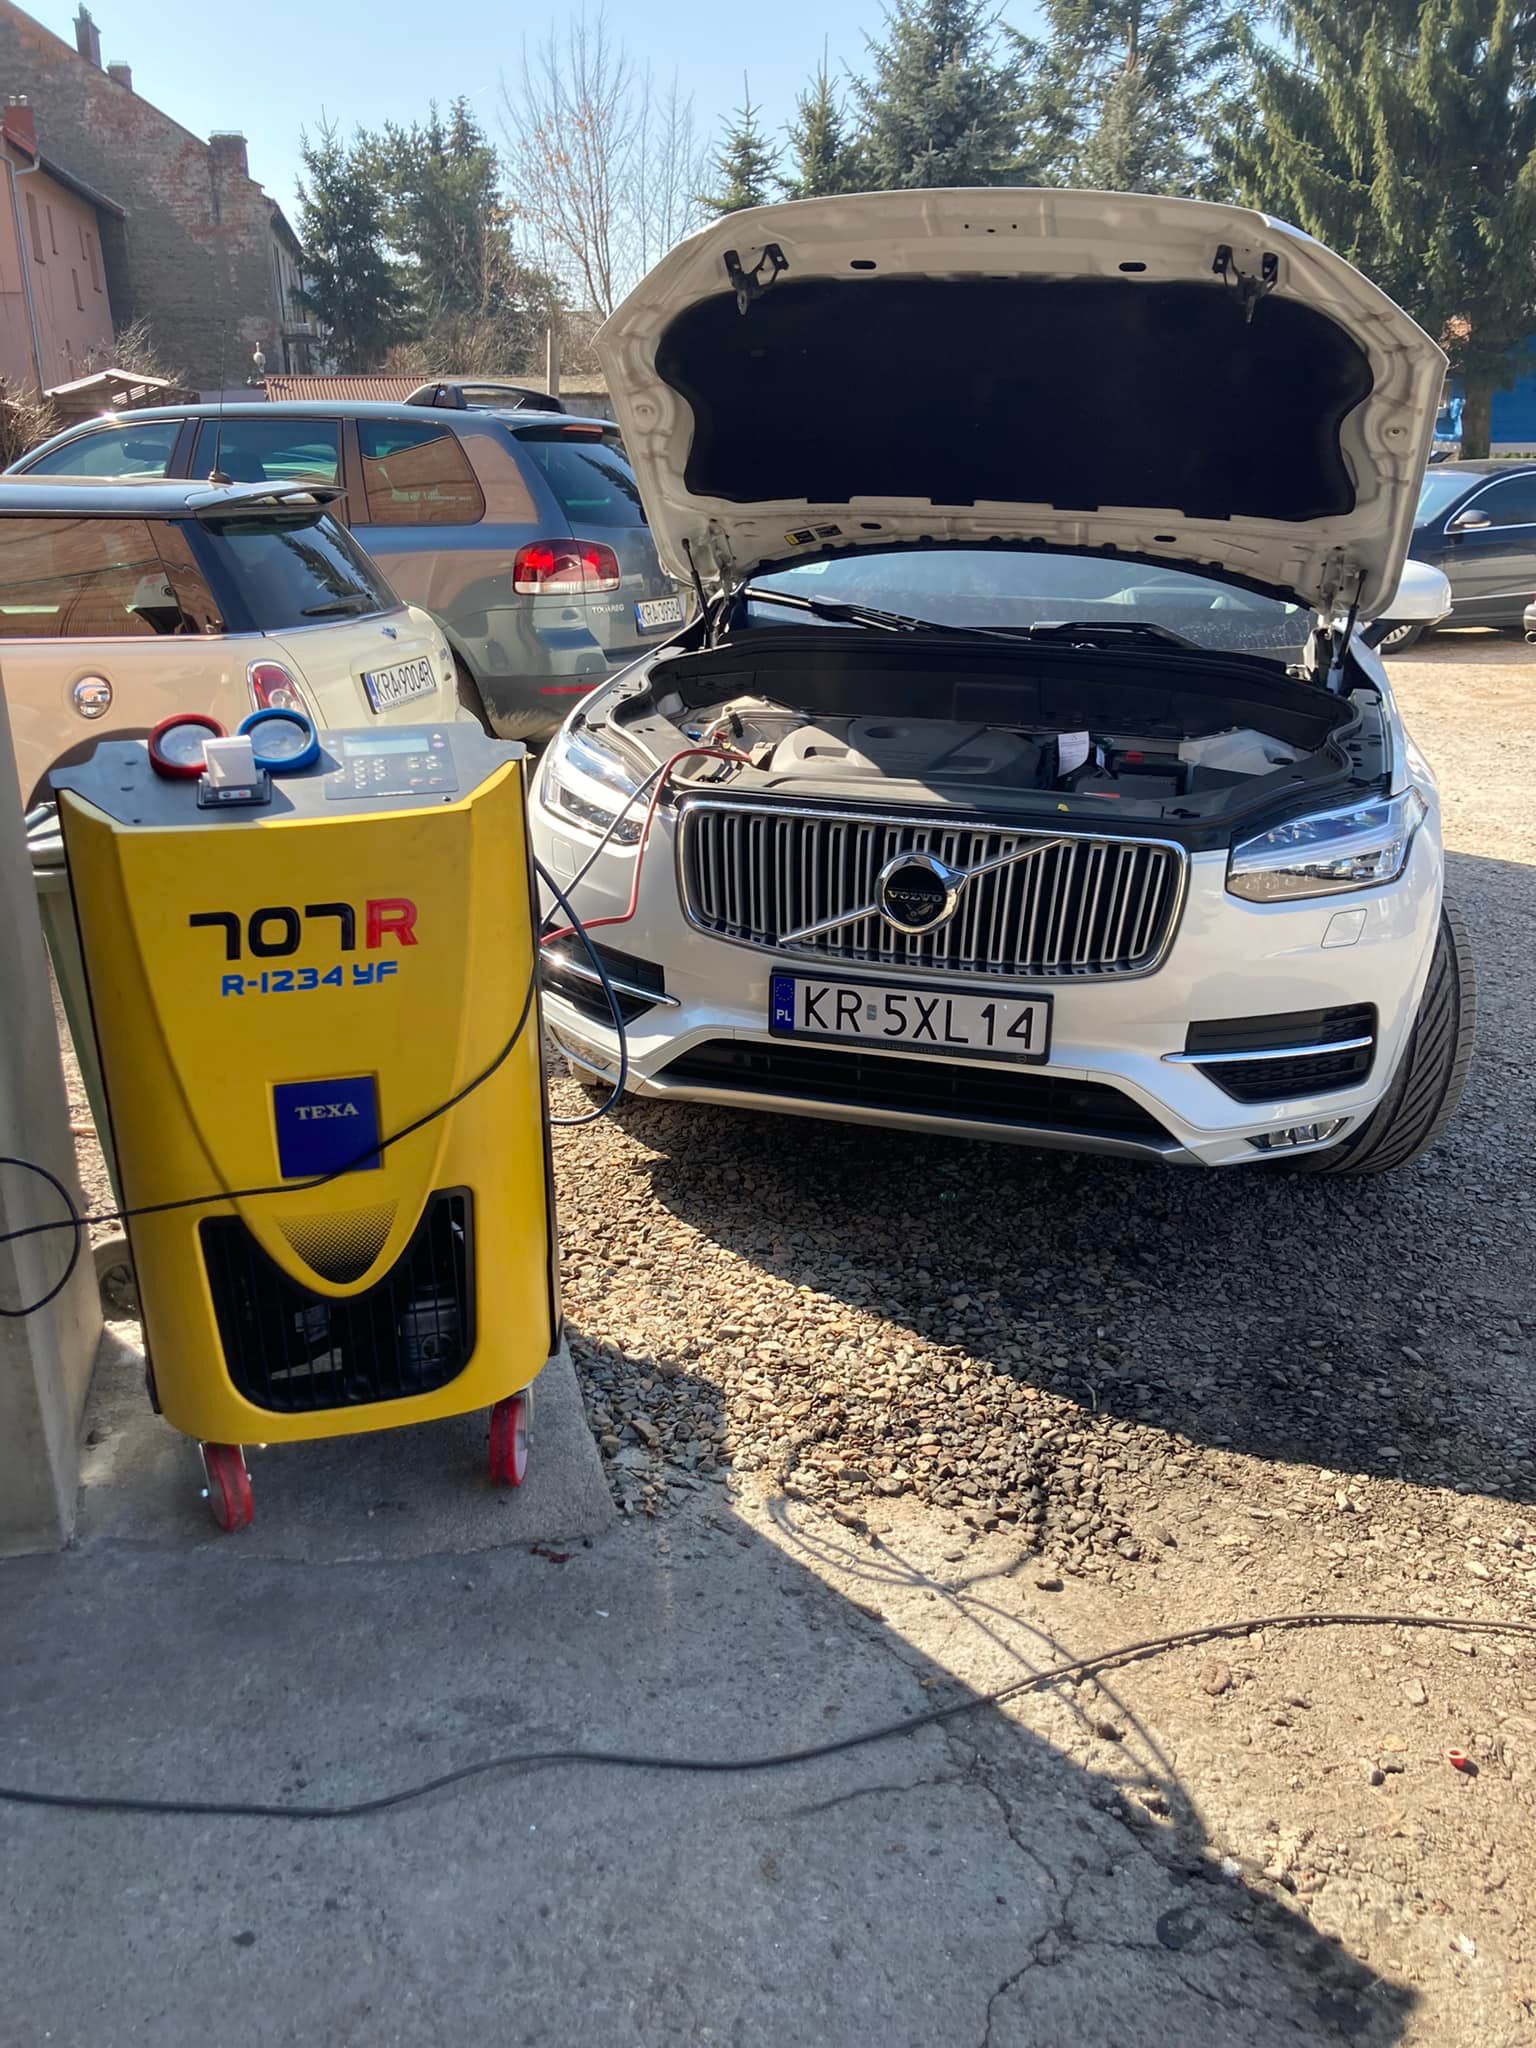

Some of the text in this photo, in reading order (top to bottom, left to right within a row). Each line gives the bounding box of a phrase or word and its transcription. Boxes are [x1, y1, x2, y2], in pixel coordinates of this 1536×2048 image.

[373, 671, 401, 702] KRA
[189, 898, 418, 960] 707R
[222, 966, 343, 997] R-1234
[776, 1009, 792, 1022] PL
[804, 986, 1034, 1050] KR 5XL14
[294, 1102, 359, 1120] TEXA
